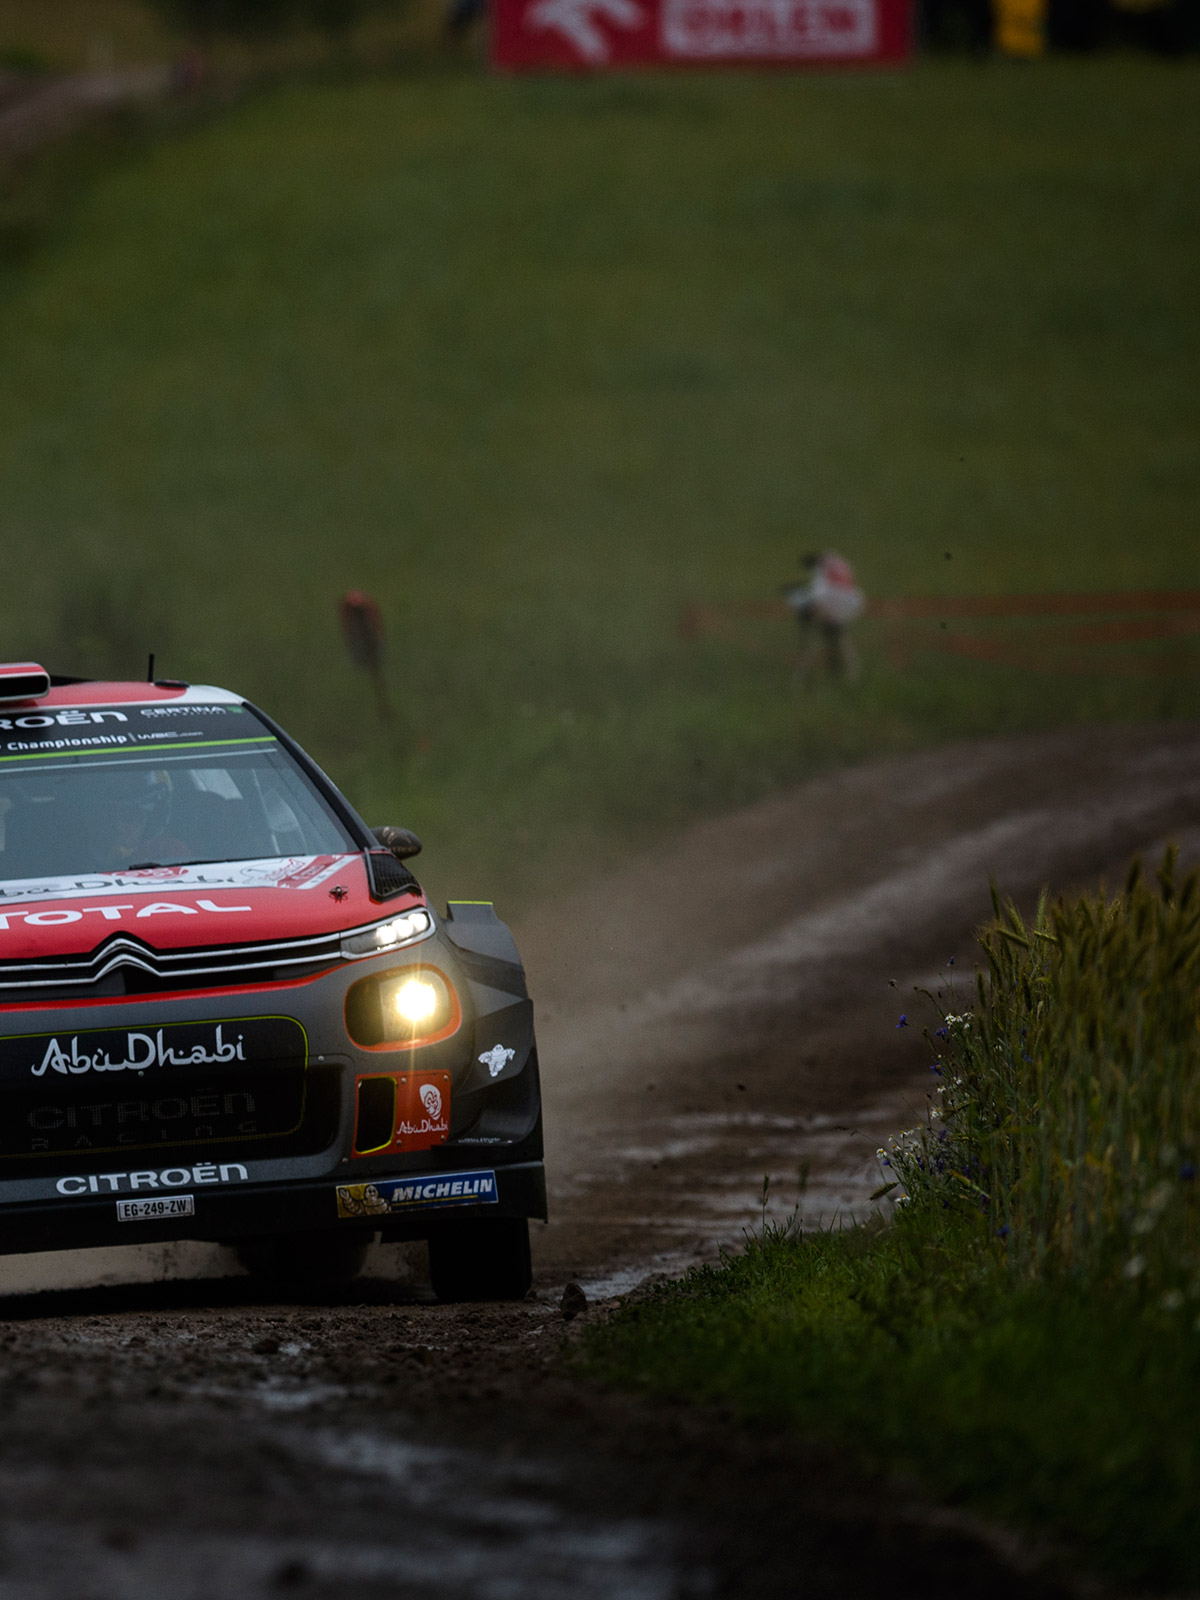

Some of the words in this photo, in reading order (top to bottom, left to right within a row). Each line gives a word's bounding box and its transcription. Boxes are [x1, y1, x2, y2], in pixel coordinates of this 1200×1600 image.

[6, 734, 128, 753] Championship
[26, 1087, 257, 1130] CITROËN
[55, 1161, 249, 1196] CITROËN
[392, 1178, 493, 1202] MICHELIN
[123, 1199, 188, 1218] EG-249-ZW
